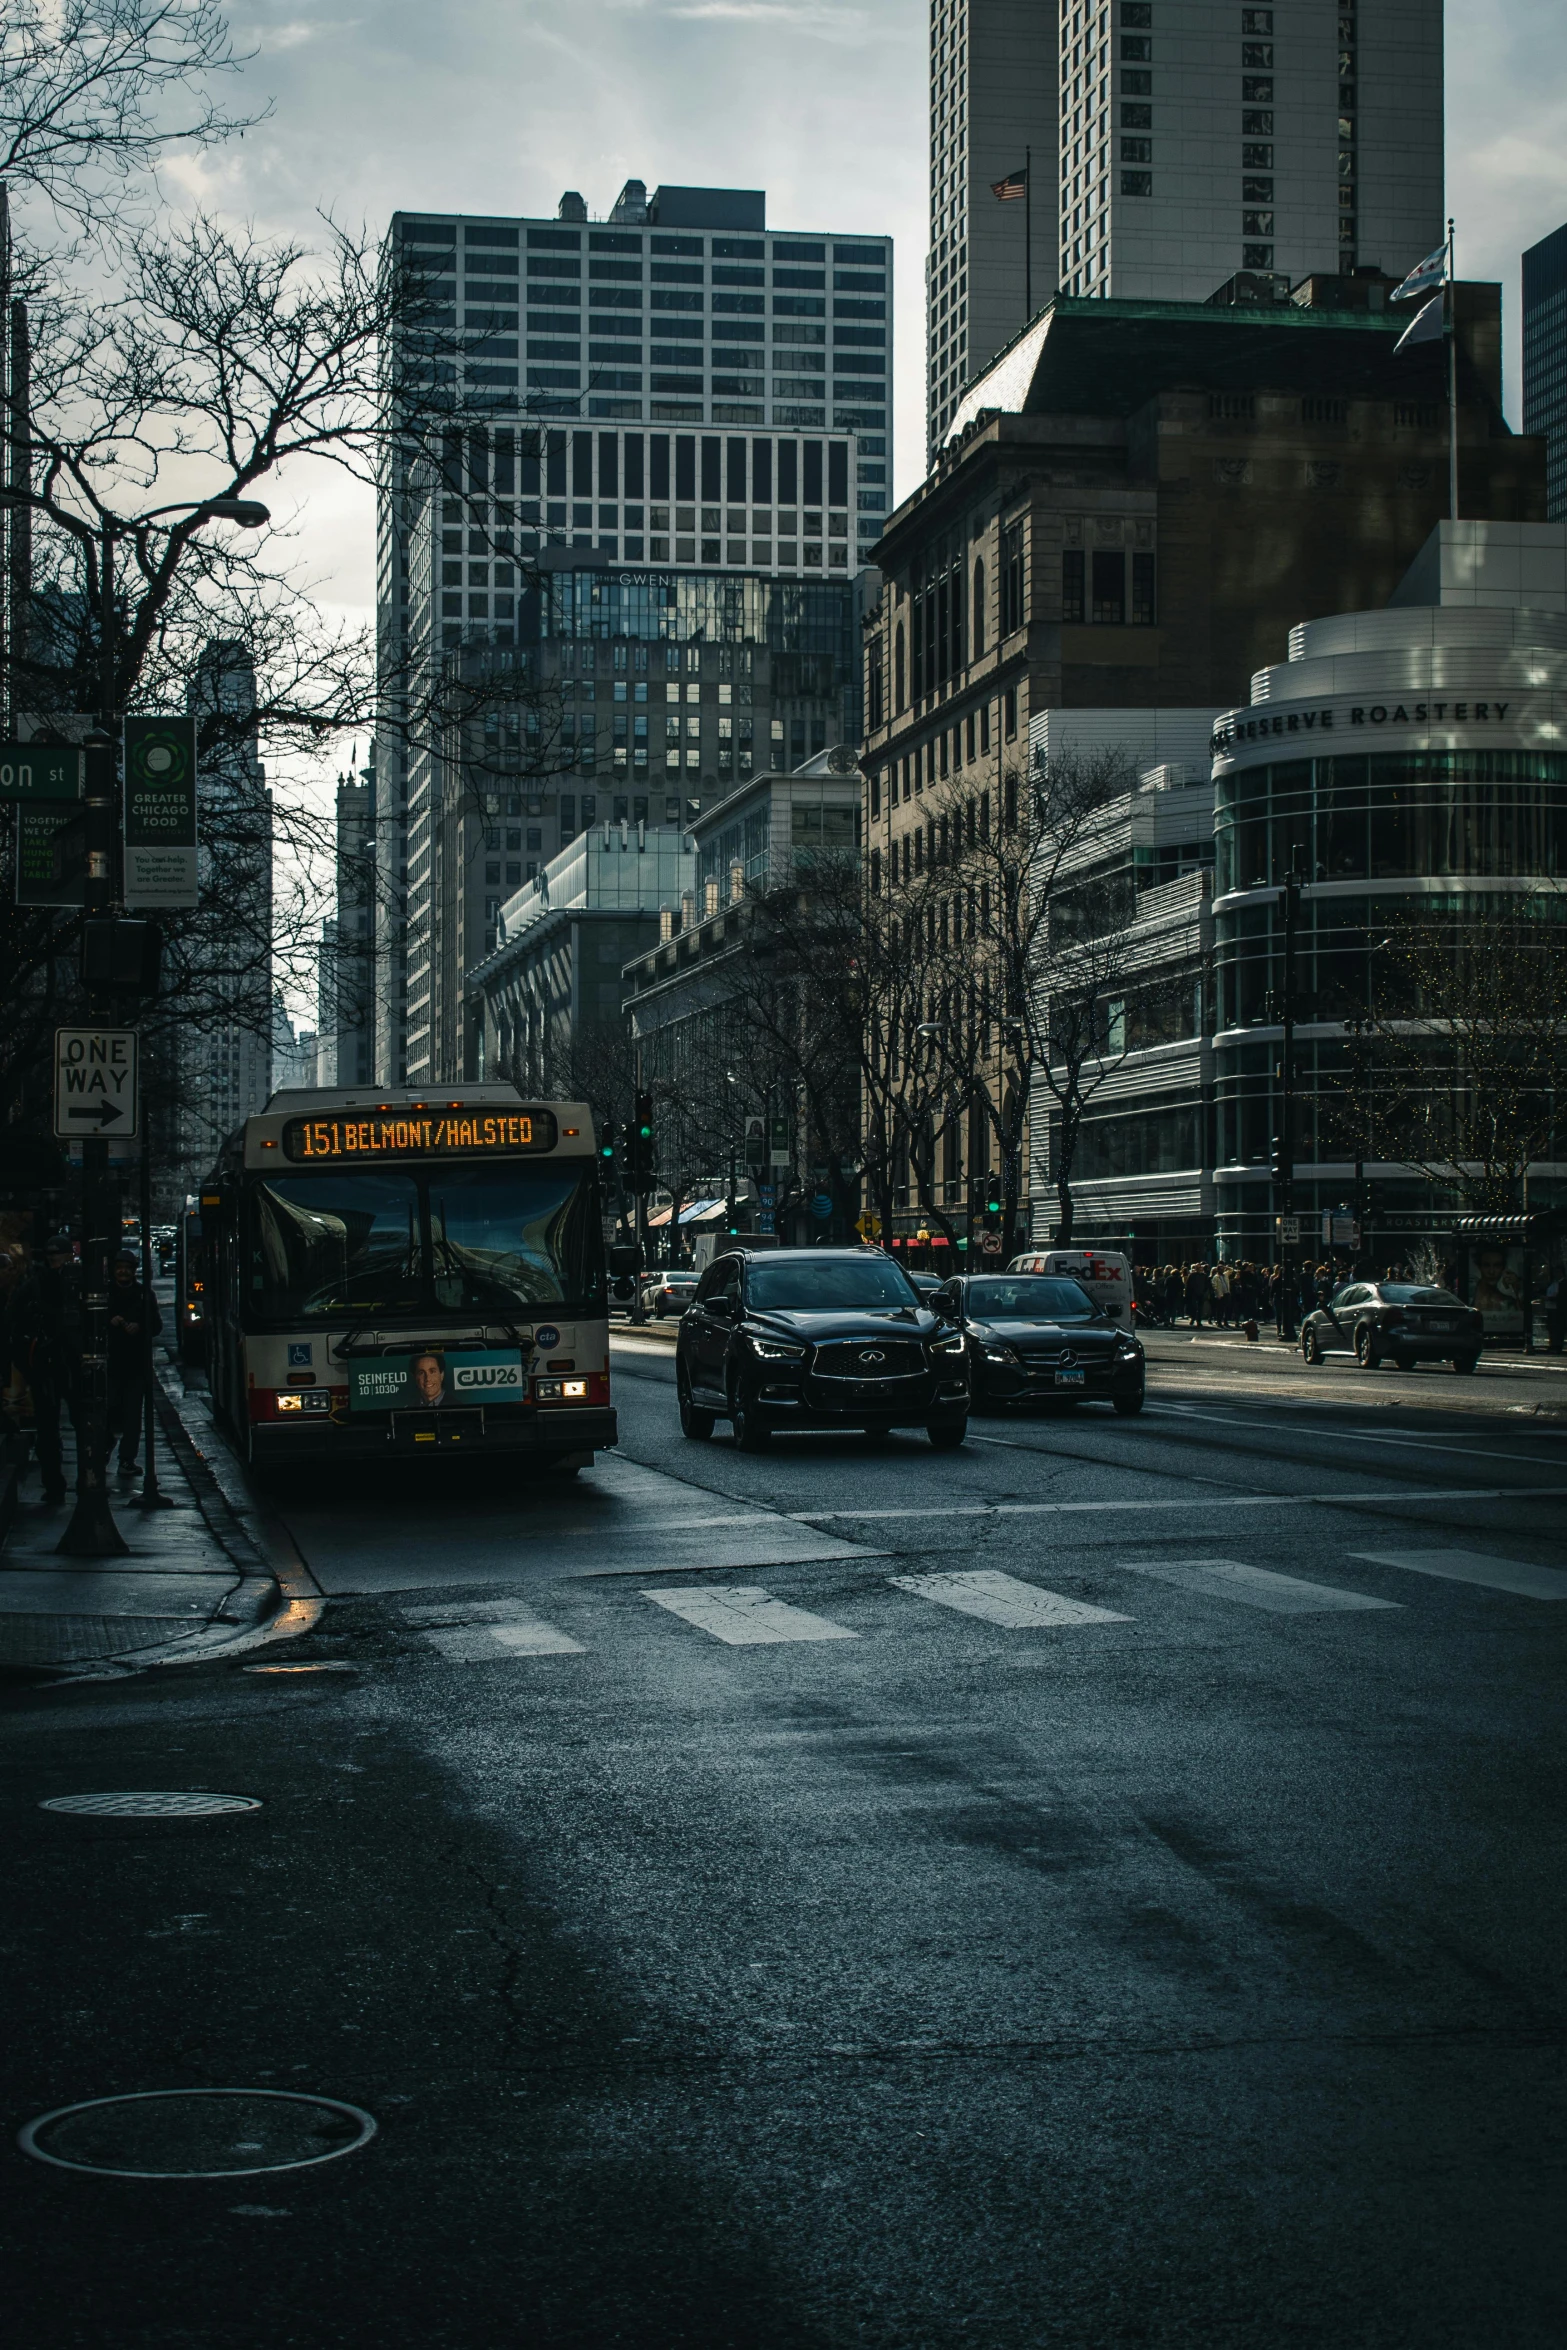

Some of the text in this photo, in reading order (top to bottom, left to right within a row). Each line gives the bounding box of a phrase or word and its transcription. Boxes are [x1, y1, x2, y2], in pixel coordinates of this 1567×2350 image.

[619, 573, 669, 587] GWEN
[1236, 703, 1510, 740] RESERVE ROASTERY
[0, 763, 65, 787] on st
[134, 793, 187, 803] GREATER
[132, 805, 189, 815] CHICAGO
[142, 817, 178, 827] FOOD
[23, 827, 40, 836] WE
[23, 838, 48, 847] TAKE
[23, 860, 42, 868] OFF
[134, 855, 150, 864] You
[167, 855, 188, 865] help.
[23, 870, 52, 879] TABLE
[136, 865, 172, 875] Together
[152, 875, 186, 883] Greater.
[67, 1038, 127, 1064] ONE
[65, 1068, 129, 1094] WAY
[302, 1117, 533, 1156] 151 BELMONT/HALSTED
[762, 1198, 773, 1206] 90
[761, 1213, 773, 1221] 94
[1282, 1218, 1298, 1227] ONE
[1386, 1217, 1457, 1228] ROASTERY
[1282, 1226, 1298, 1234] WAY
[1054, 1259, 1122, 1281] FedEx
[539, 1332, 556, 1342] cta
[358, 1371, 408, 1386] SEINFELD
[359, 1386, 370, 1396] 10
